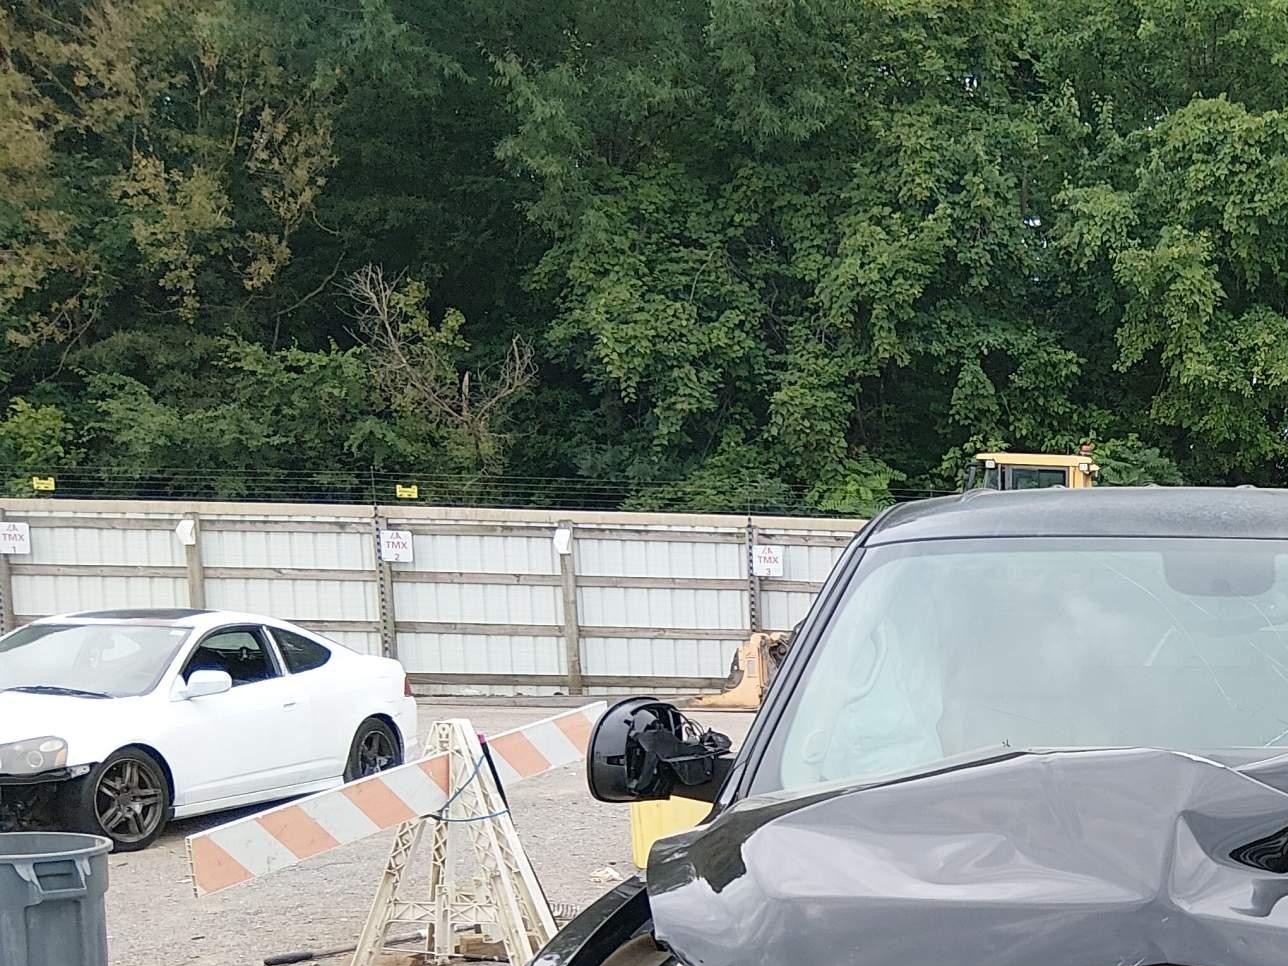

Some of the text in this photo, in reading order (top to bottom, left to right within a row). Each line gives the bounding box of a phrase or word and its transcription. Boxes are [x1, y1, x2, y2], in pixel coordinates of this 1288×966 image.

[1, 533, 25, 541] TMX
[386, 541, 408, 549] TMX
[757, 556, 779, 564] TMX
